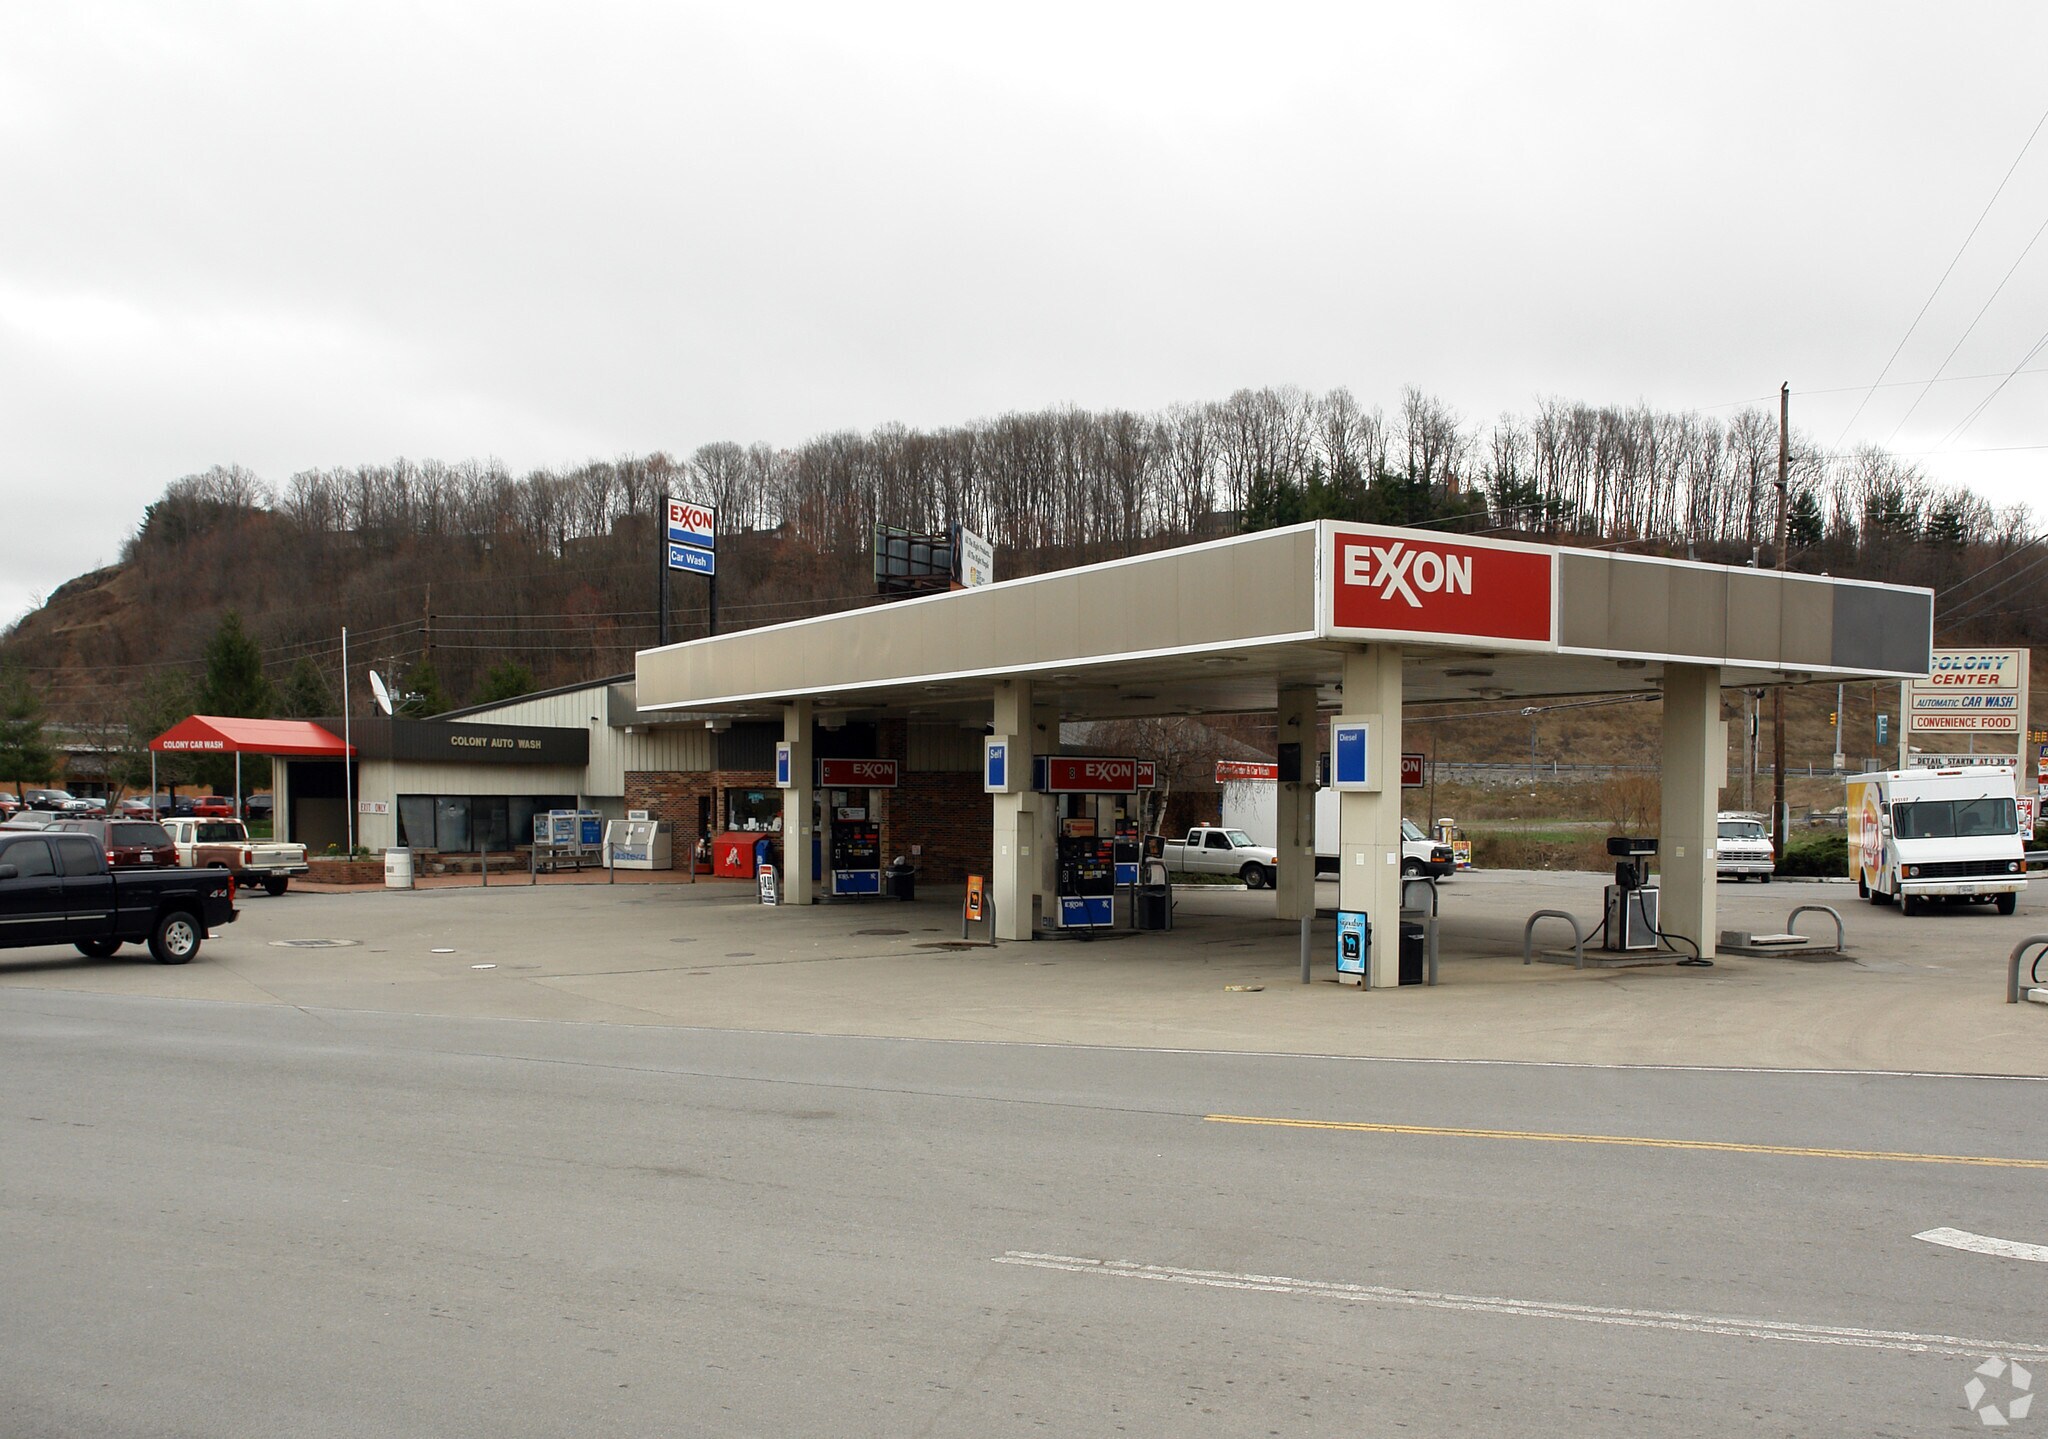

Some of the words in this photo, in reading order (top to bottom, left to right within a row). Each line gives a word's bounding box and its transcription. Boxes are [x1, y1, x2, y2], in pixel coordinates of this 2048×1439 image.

[671, 505, 712, 532] EXXON
[671, 551, 684, 562] Car
[686, 553, 706, 566] Wash
[1344, 542, 1473, 608] EXXON
[1932, 674, 2000, 685] CENTER
[1917, 699, 1959, 707] AUTOMATIC
[1961, 696, 1982, 707] CAR
[1985, 696, 2014, 707] WASH
[1917, 717, 1976, 727] CONVENIENCE
[1981, 717, 2011, 727] FOOD
[451, 736, 487, 747] COLONY
[491, 737, 514, 748] AUTO
[518, 739, 542, 749] WASH
[1340, 733, 1357, 741] Diesel
[163, 740, 189, 749] COLONY
[190, 740, 203, 749] CAR
[204, 740, 223, 749] WASH
[990, 749, 1002, 759] Self
[1917, 757, 1942, 765] DETAIL
[853, 762, 893, 779] EXXON
[1086, 762, 1131, 782] EXXON
[1064, 901, 1084, 909] EXXON
